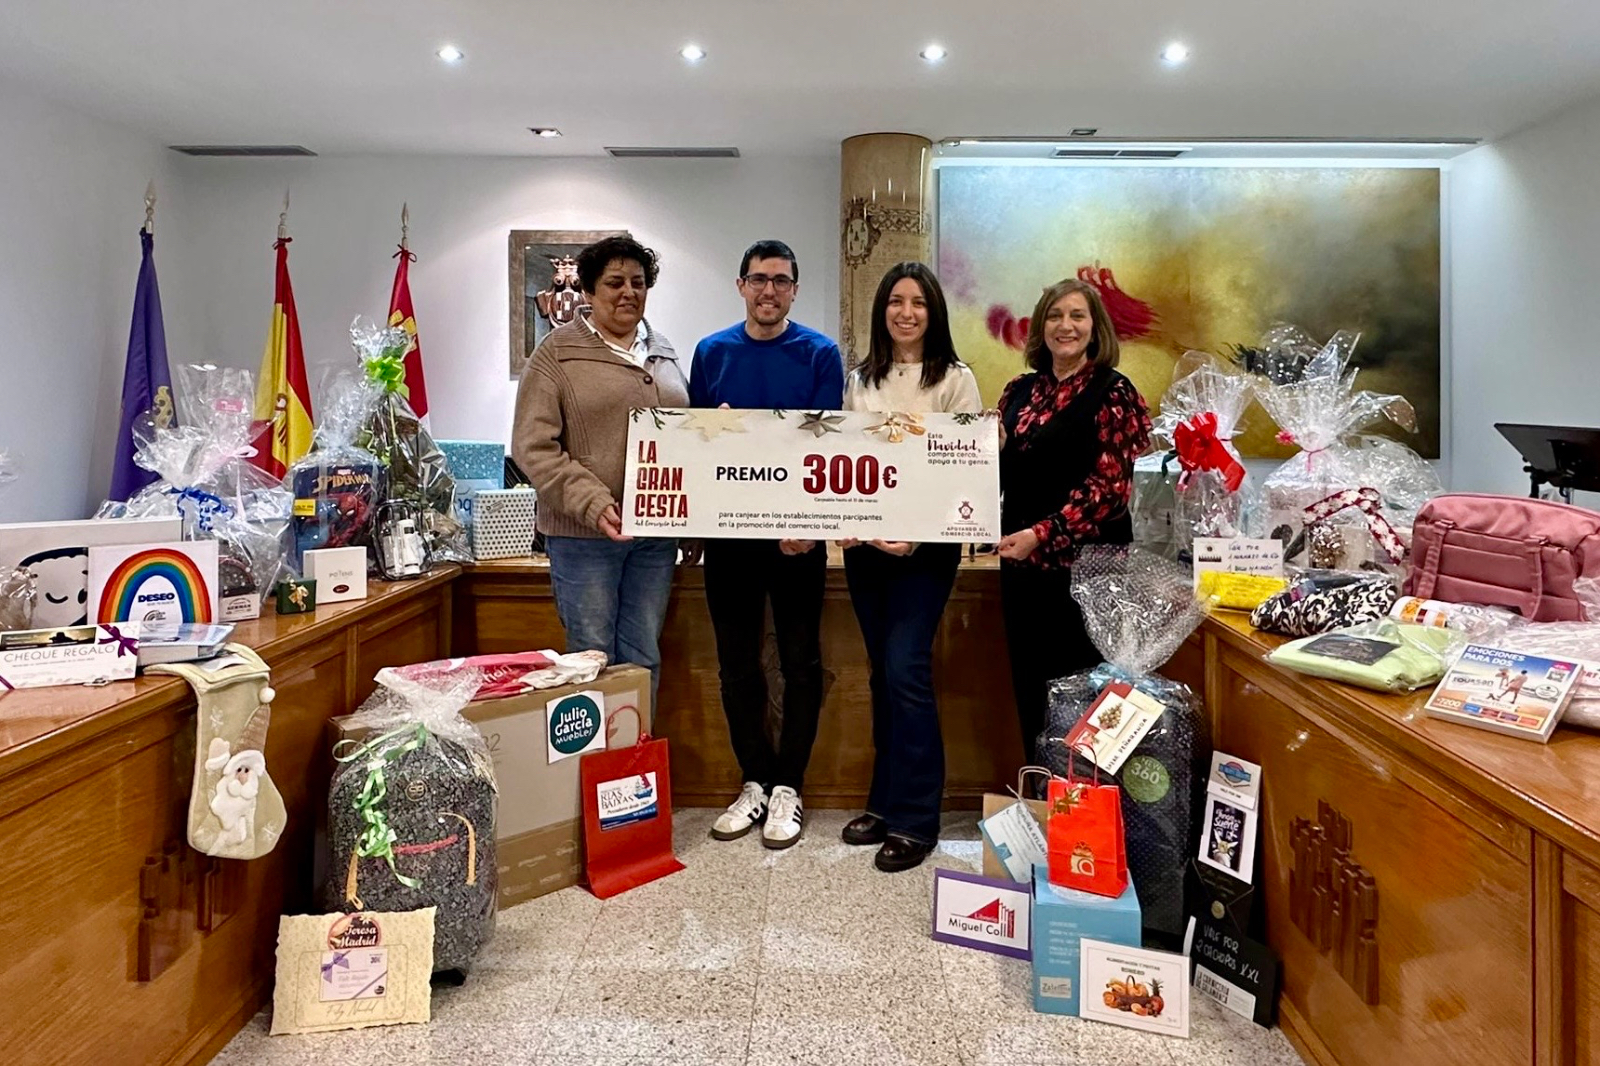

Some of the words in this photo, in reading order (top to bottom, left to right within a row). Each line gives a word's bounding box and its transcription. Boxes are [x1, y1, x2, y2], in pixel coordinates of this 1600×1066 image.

[638, 440, 657, 464] LA
[636, 467, 683, 491] GRAN
[716, 466, 788, 482] PREMIO
[803, 454, 898, 495] 300€
[634, 494, 688, 518] CESTA
[718, 512, 734, 520] para
[735, 512, 760, 521] canjear
[783, 512, 842, 520] establecimientos
[842, 513, 883, 522] parcipantes
[736, 521, 775, 530] promoción
[775, 521, 787, 529] del
[788, 522, 821, 530] comercio
[822, 522, 840, 530] local.
[138, 592, 175, 603] DESEO
[4, 650, 58, 663] CHEQUE
[64, 645, 116, 657] REGALO
[1463, 653, 1490, 663] PARA
[1492, 657, 1514, 667] DOS
[1467, 647, 1526, 662] EMOCIONES
[560, 707, 588, 726] Julio
[1120, 718, 1148, 754] PEÑARANDA
[601, 795, 634, 809] BAIXAS
[1214, 817, 1240, 831] Suerte
[345, 926, 376, 935] Teresa
[949, 917, 982, 932] Miguel
[340, 935, 376, 947] Madrid
[1223, 935, 1239, 954] POR
